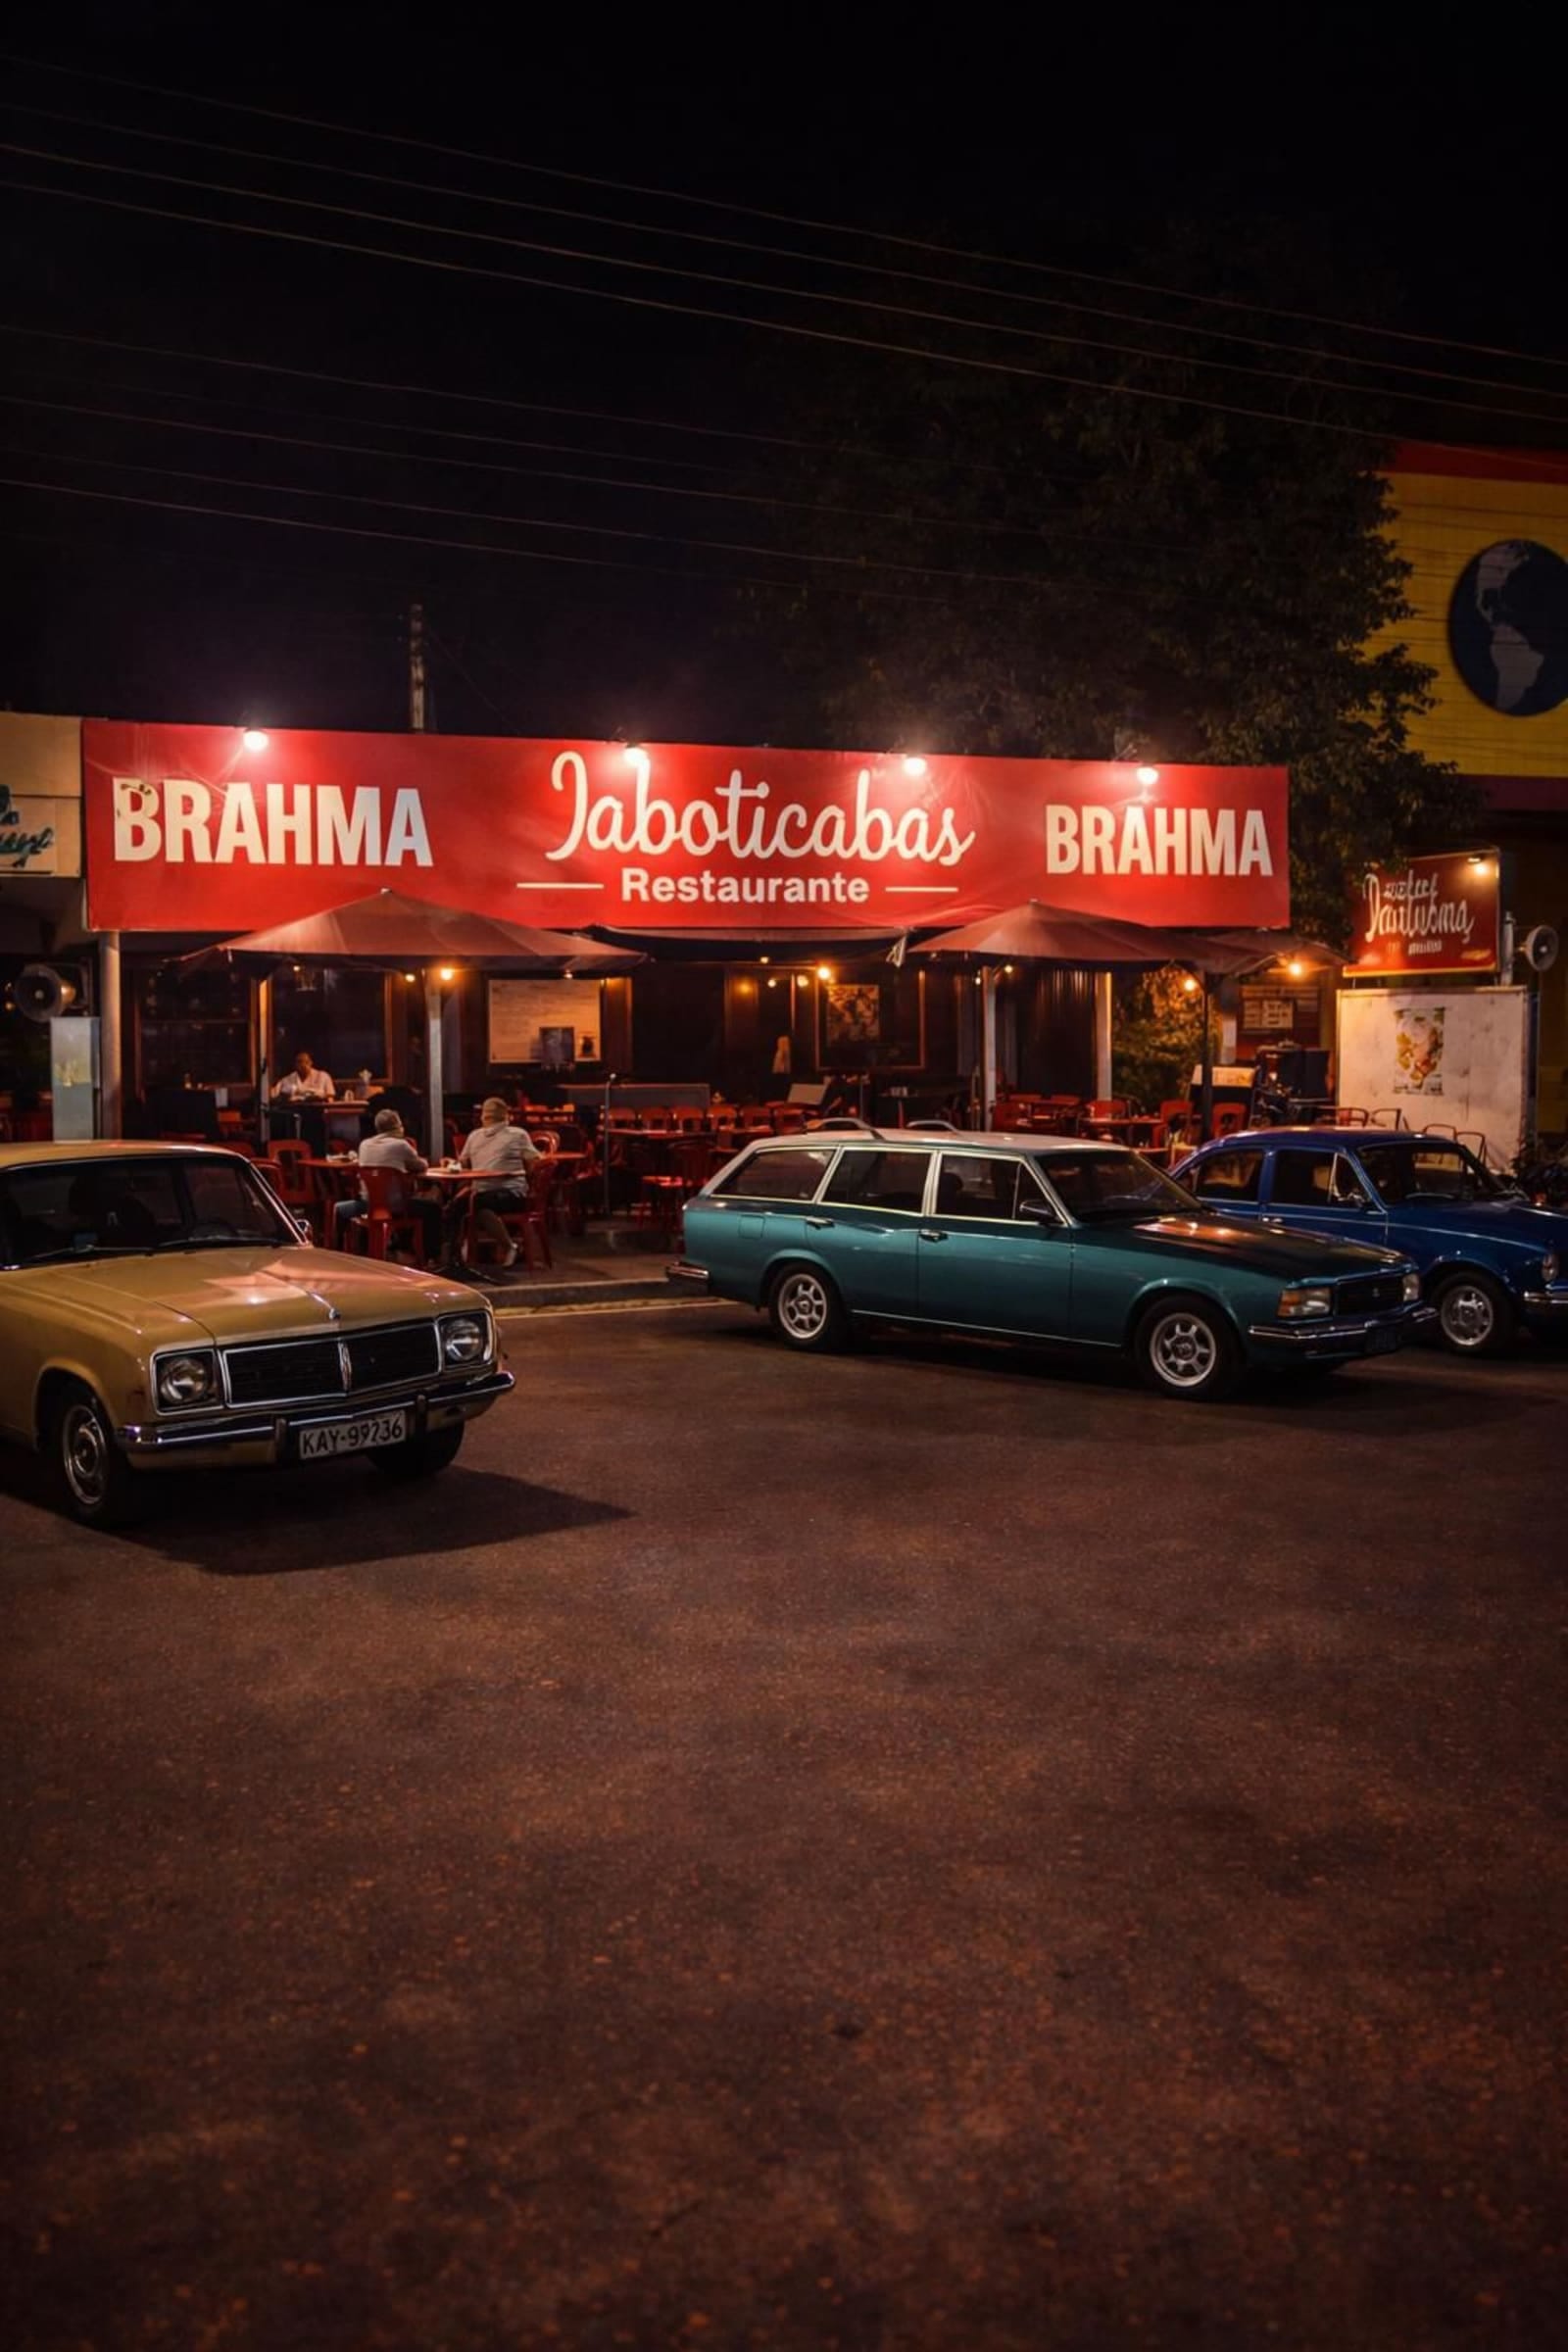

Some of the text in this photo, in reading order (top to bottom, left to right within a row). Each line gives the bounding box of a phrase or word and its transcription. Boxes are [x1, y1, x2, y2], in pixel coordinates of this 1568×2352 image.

[113, 778, 433, 867] BRAHMA
[546, 750, 976, 866] Jaboticabas
[1046, 804, 1273, 876] BRAHMA
[621, 868, 869, 903] Restaurante
